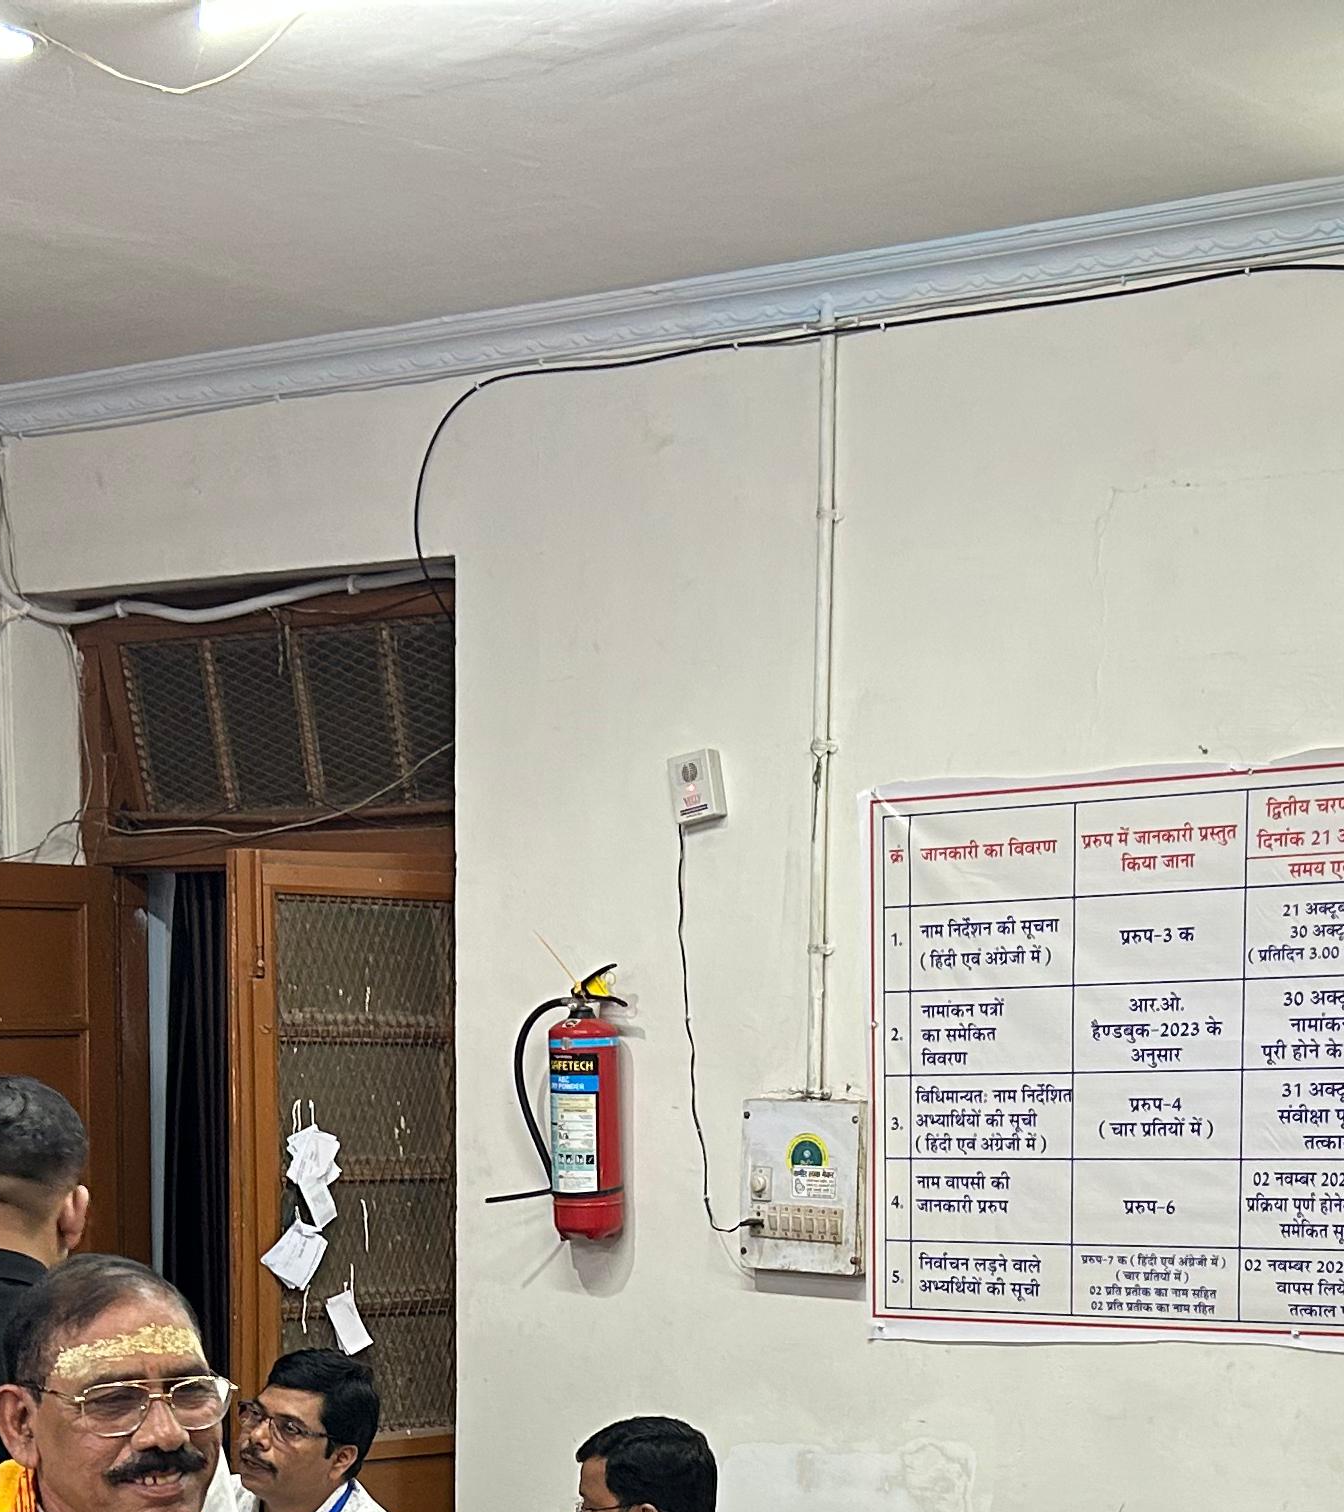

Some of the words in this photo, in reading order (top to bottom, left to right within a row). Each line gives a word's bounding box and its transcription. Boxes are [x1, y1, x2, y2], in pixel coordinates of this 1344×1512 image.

[1117, 827, 1129, 846] में
[1133, 822, 1194, 844] जानकारी
[1198, 825, 1237, 846] प्रस्तुत
[1256, 828, 1305, 850] दिनांक
[1312, 830, 1329, 845] 21
[920, 840, 979, 861] जानकारी
[983, 844, 1004, 857] का
[1008, 838, 1057, 856] विवरण
[1122, 853, 1158, 872] किया
[1161, 854, 1195, 868] जाना
[1288, 862, 1326, 878] समय
[1283, 903, 1298, 916] 21
[920, 924, 944, 938] नाम
[996, 916, 1016, 935] की
[1020, 919, 1060, 940] सूचना
[1177, 926, 1195, 942] क
[1290, 925, 1306, 938] 30
[891, 932, 902, 946] 1.
[921, 1000, 975, 1018] नामांकन
[978, 997, 1004, 1016] पत्रों
[1283, 991, 1304, 1006] 30
[891, 1028, 903, 1041] 2.
[1205, 1015, 1224, 1036] के
[921, 1029, 941, 1042] का
[921, 1048, 968, 1066] विवरण
[1131, 1048, 1183, 1068] अनुसार
[1261, 1039, 1287, 1065] पूरी
[1291, 1038, 1320, 1061] होने
[1325, 1038, 1343, 1058] के
[1282, 1083, 1300, 1097] 31
[891, 1117, 904, 1130] 3.
[984, 1109, 1005, 1127] की
[1008, 1108, 1038, 1132] सूची
[916, 1176, 941, 1189] नाम
[944, 1171, 986, 1190] वापसी
[990, 1171, 1010, 1190] की
[1254, 1172, 1269, 1186] 02
[1274, 1172, 1317, 1186] नवम्बर
[891, 1195, 904, 1209] 4.
[916, 1194, 973, 1213] जानकारी
[1246, 1192, 1289, 1212] प्रक्रिया
[1292, 1192, 1316, 1218] पूर्ण
[918, 1252, 970, 1271] निर्वाचन
[1011, 1254, 1041, 1273] वाले
[892, 1270, 904, 1284] 5.
[985, 1277, 1006, 1296] की
[1009, 1278, 1040, 1302] सूची
[1276, 1282, 1314, 1295] वापस
[1288, 1304, 1337, 1317] तत्काल
